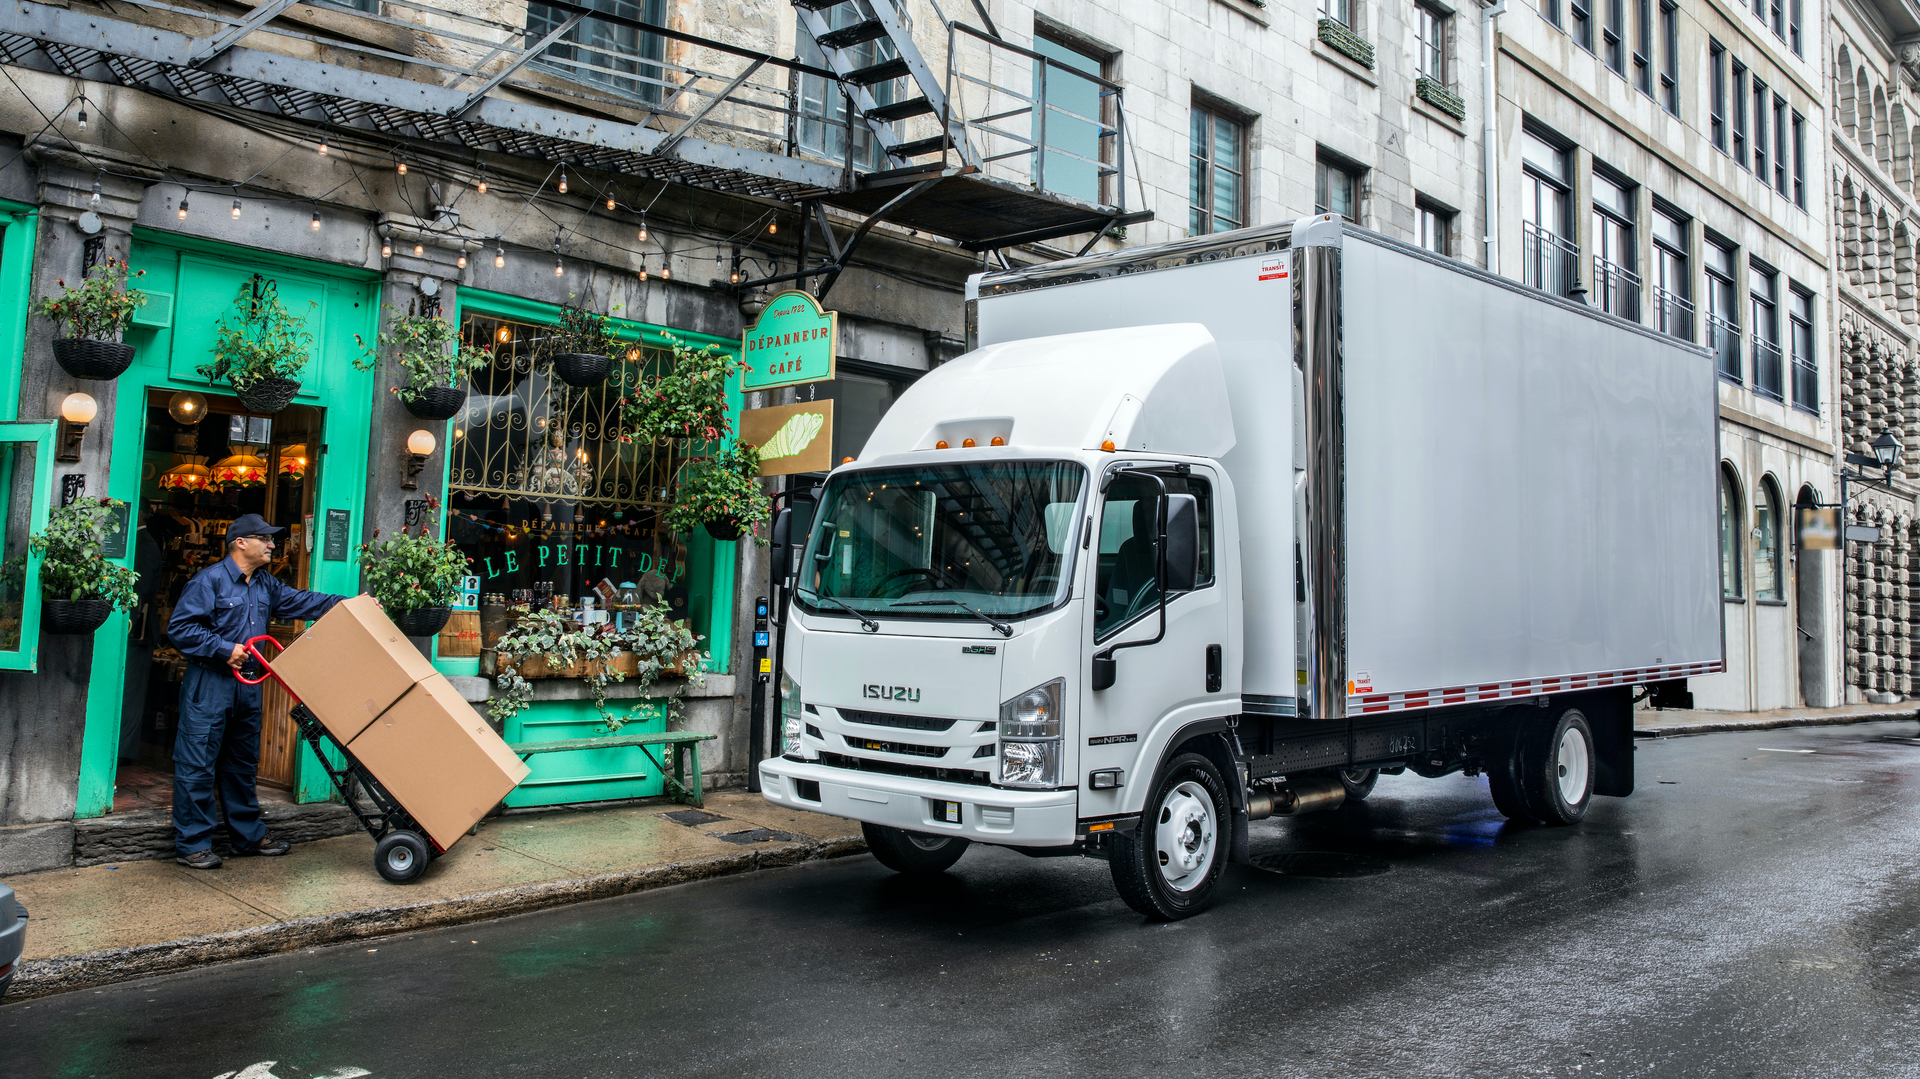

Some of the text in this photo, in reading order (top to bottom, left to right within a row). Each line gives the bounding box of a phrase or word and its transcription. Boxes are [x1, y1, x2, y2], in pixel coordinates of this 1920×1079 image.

[1261, 264, 1285, 272] TRANSIT
[773, 307, 790, 320] Depuis
[749, 327, 829, 352] DÉPANNEUR
[769, 355, 803, 375] CAFÉ
[521, 517, 601, 534] DÉPANNEUR
[484, 550, 519, 580] LE
[537, 544, 623, 568] PETIT
[759, 606, 765, 614] P
[457, 631, 477, 640] ATM
[863, 683, 921, 703] ISUZU
[1103, 735, 1127, 744] NPR
